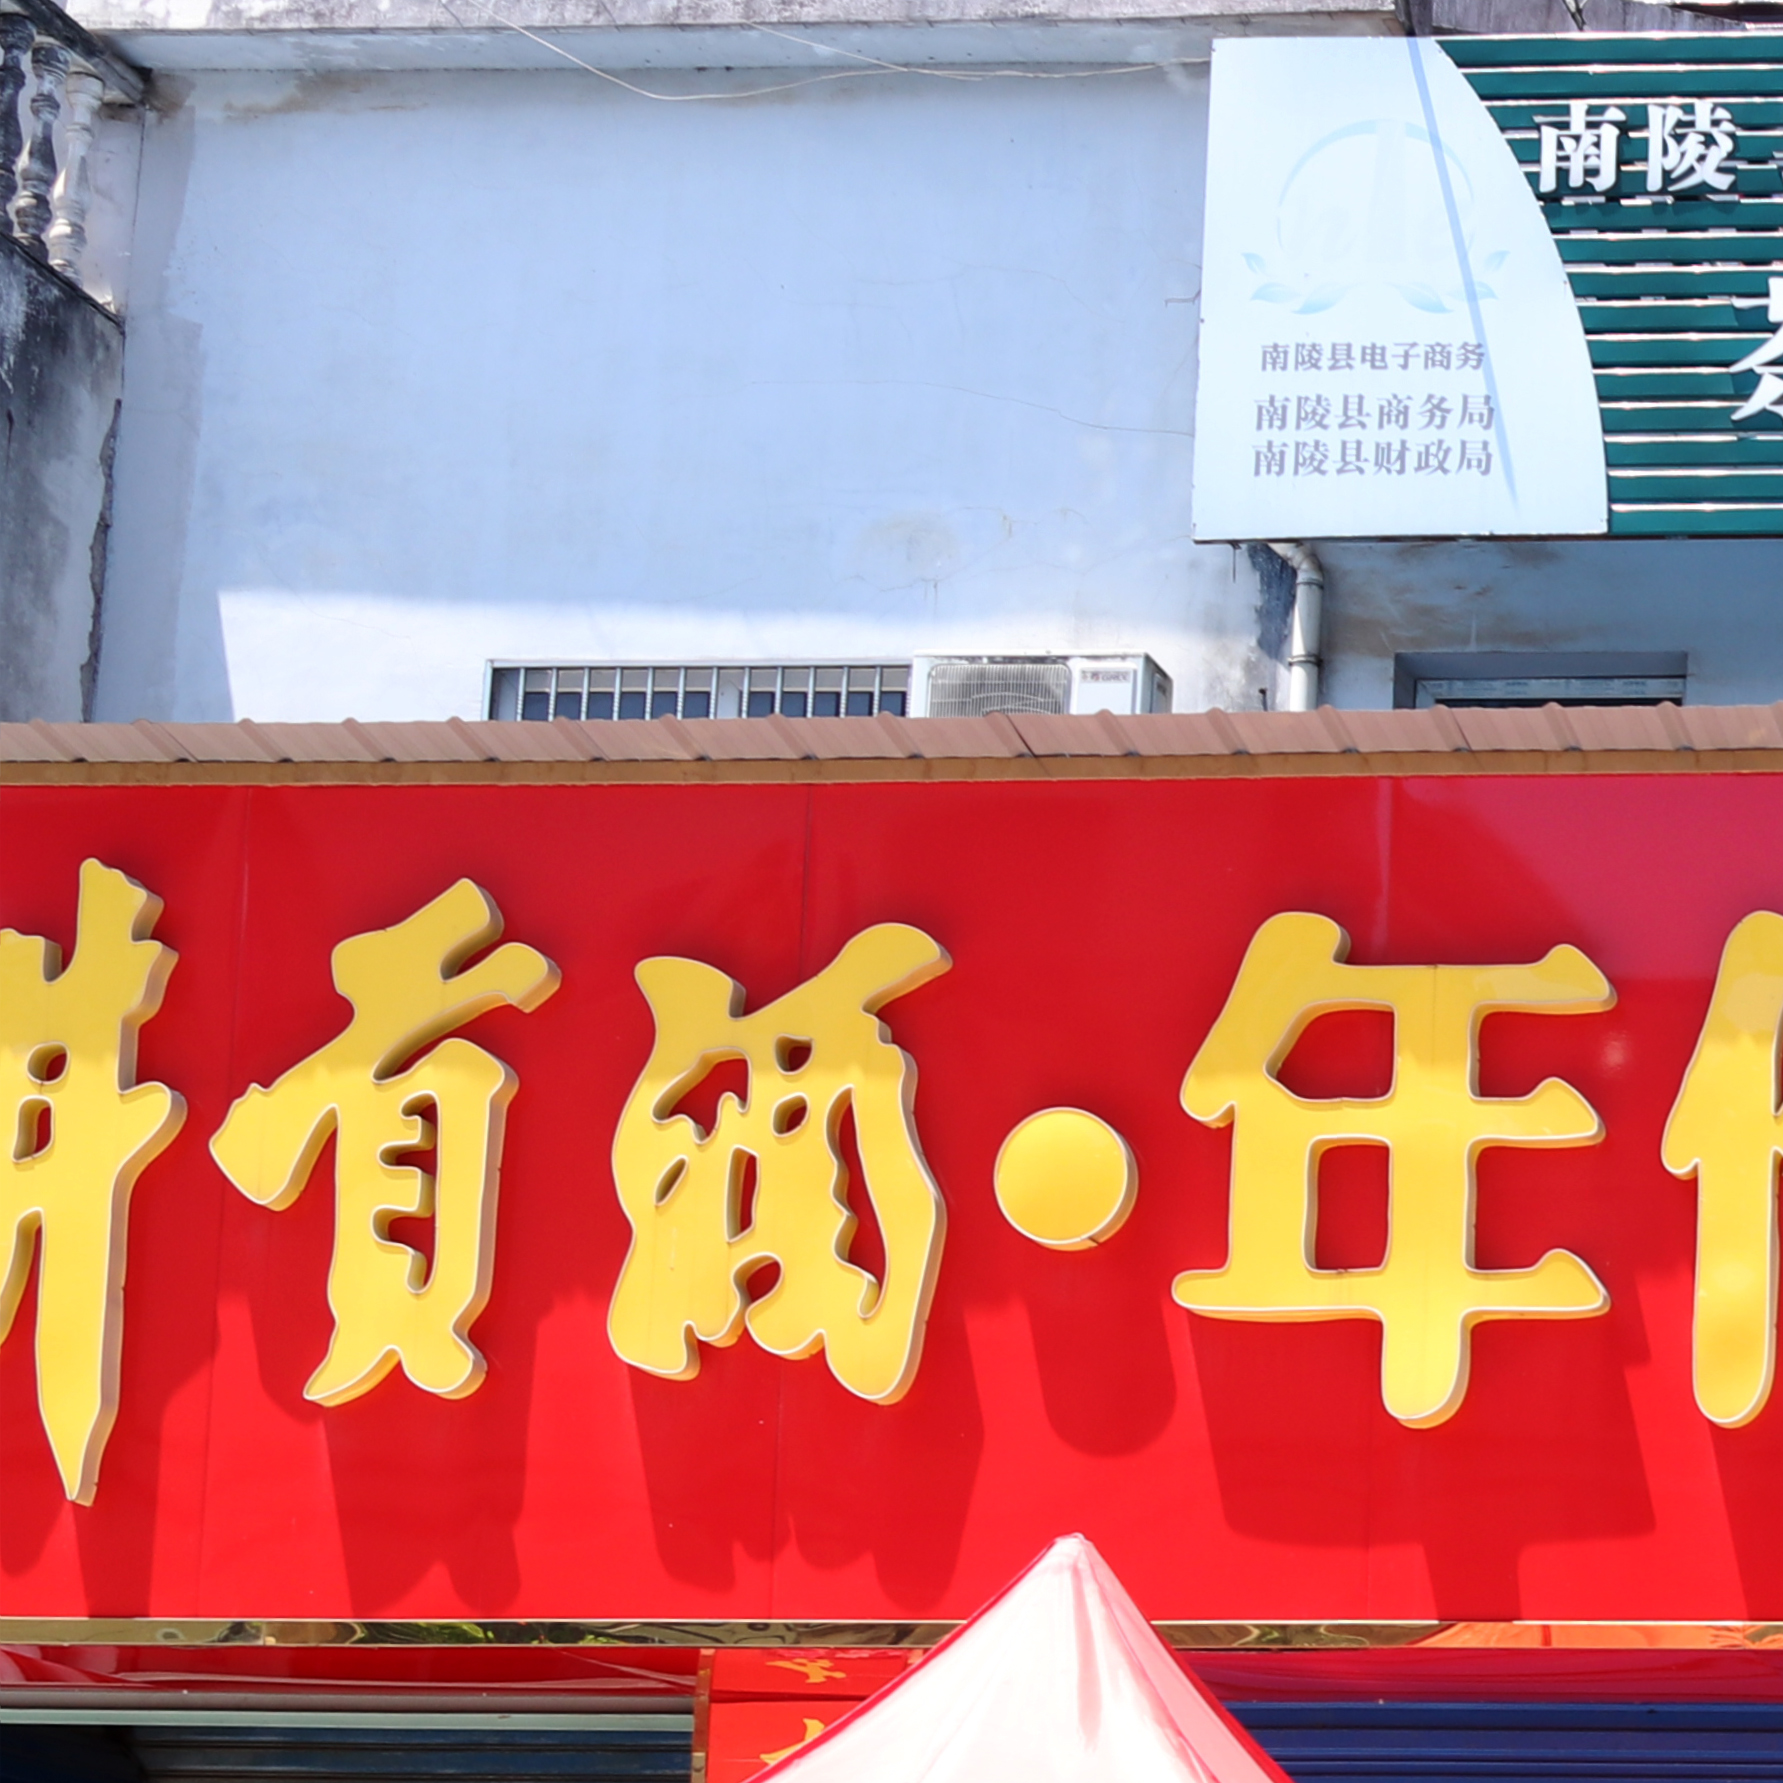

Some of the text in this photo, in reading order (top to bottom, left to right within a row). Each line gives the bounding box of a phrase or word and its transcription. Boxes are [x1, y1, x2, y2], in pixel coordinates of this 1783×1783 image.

[1260, 342, 1486, 371] 南陵县电子商务
[1254, 394, 1496, 431] 南陵县商务局
[1252, 439, 1494, 477] 南陵县财政局
